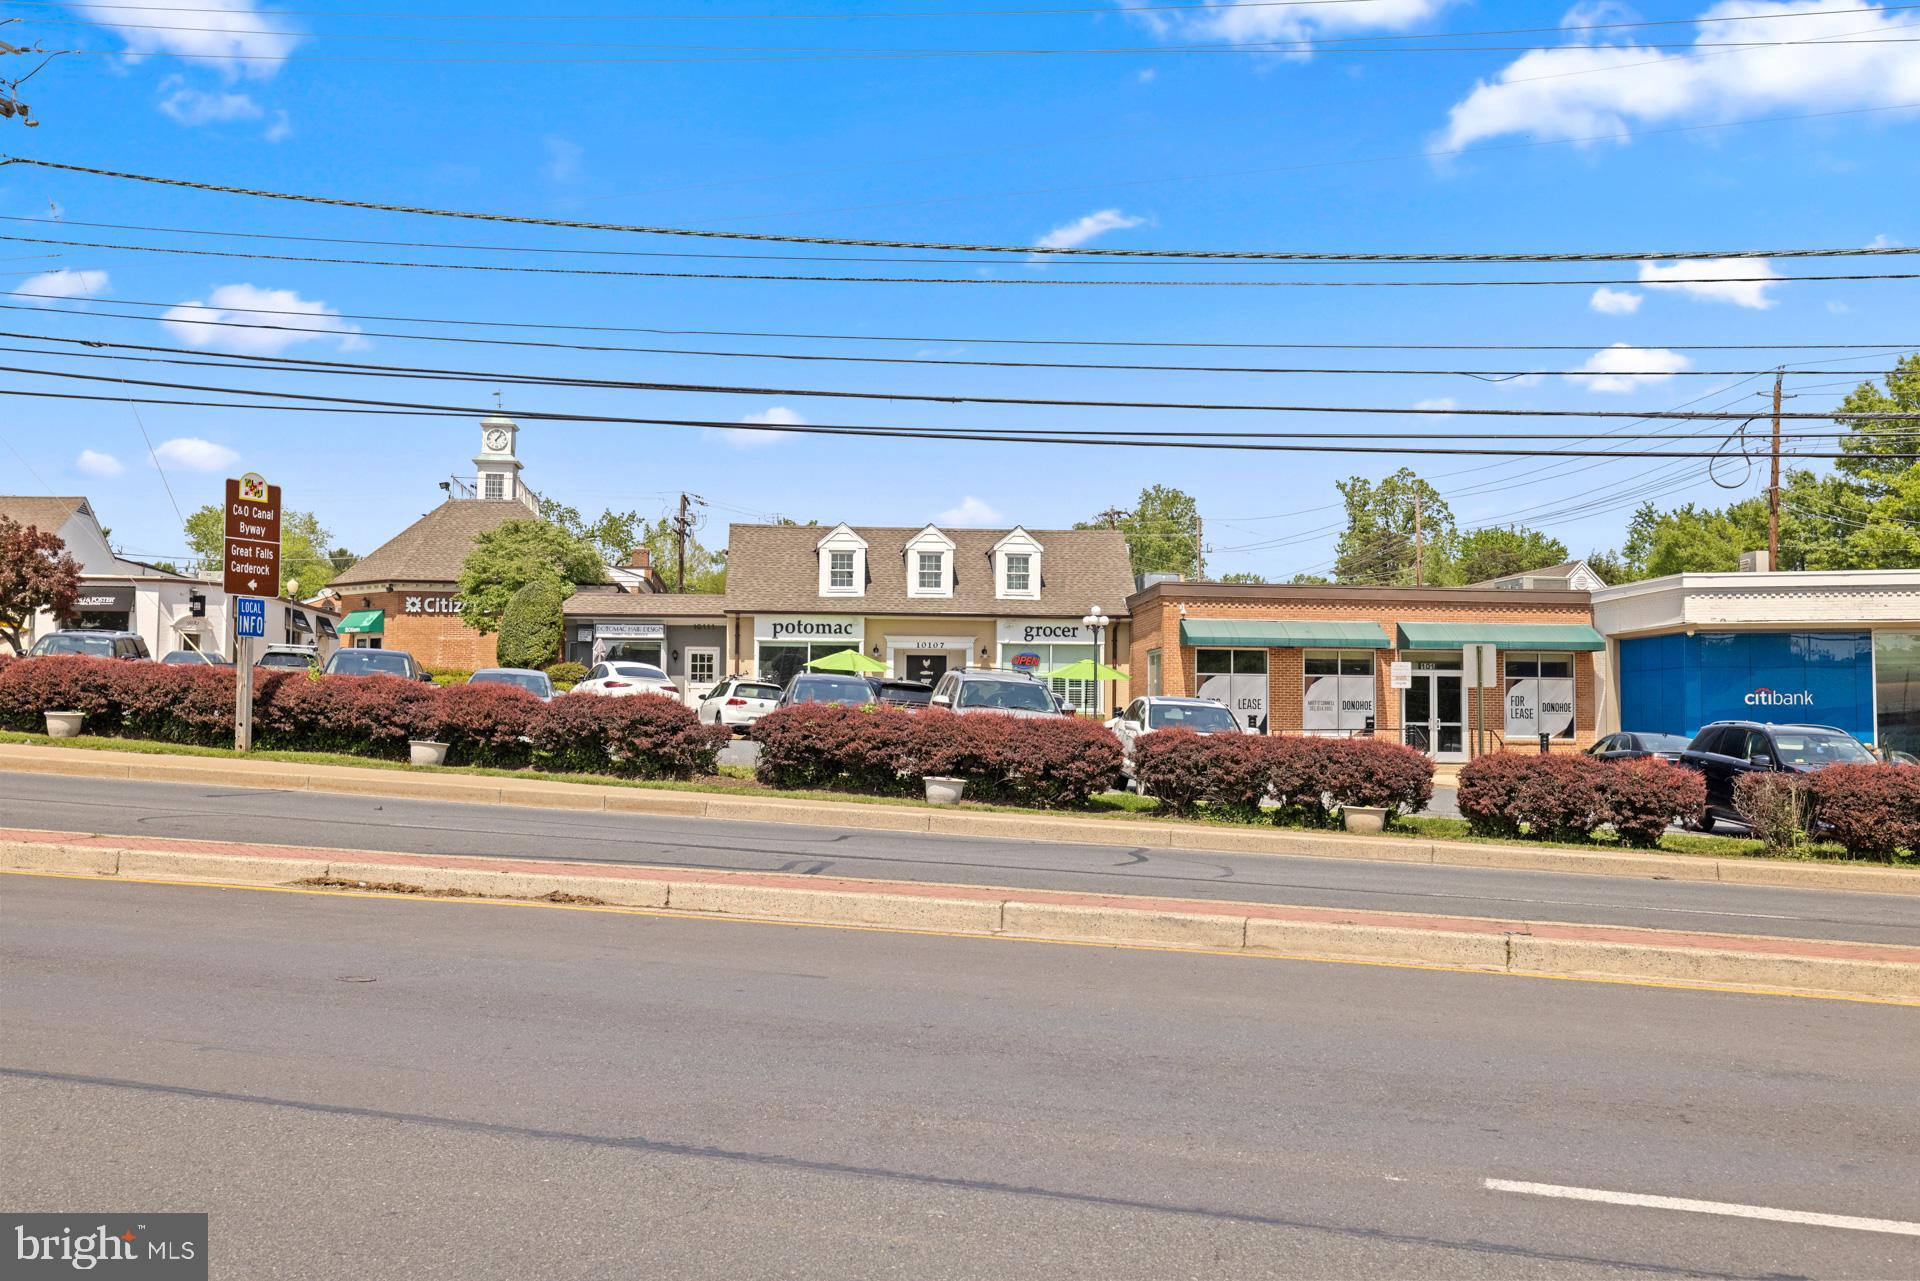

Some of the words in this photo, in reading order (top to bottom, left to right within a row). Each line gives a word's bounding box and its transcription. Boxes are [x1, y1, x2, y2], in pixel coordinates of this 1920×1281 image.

[233, 504, 249, 517] C&O
[252, 507, 274, 520] Canal
[239, 522, 266, 537] Byway
[231, 544, 253, 558] Great
[255, 548, 274, 560] Falls
[231, 561, 270, 575] Carderock
[241, 601, 262, 614] LOCAL
[423, 597, 490, 613] Citiz
[239, 615, 264, 634] INFO
[772, 620, 853, 639] potomac
[1024, 625, 1079, 642] grocer
[916, 641, 945, 649] 10107
[1011, 655, 1041, 667] OPEN
[1237, 698, 1262, 710] LEASE
[1510, 696, 1525, 707] FOR
[1744, 689, 1814, 705] citibank
[1342, 700, 1373, 711] DONOHOE
[1542, 702, 1572, 712] DONOHOE
[1510, 708, 1534, 719] LEASE
